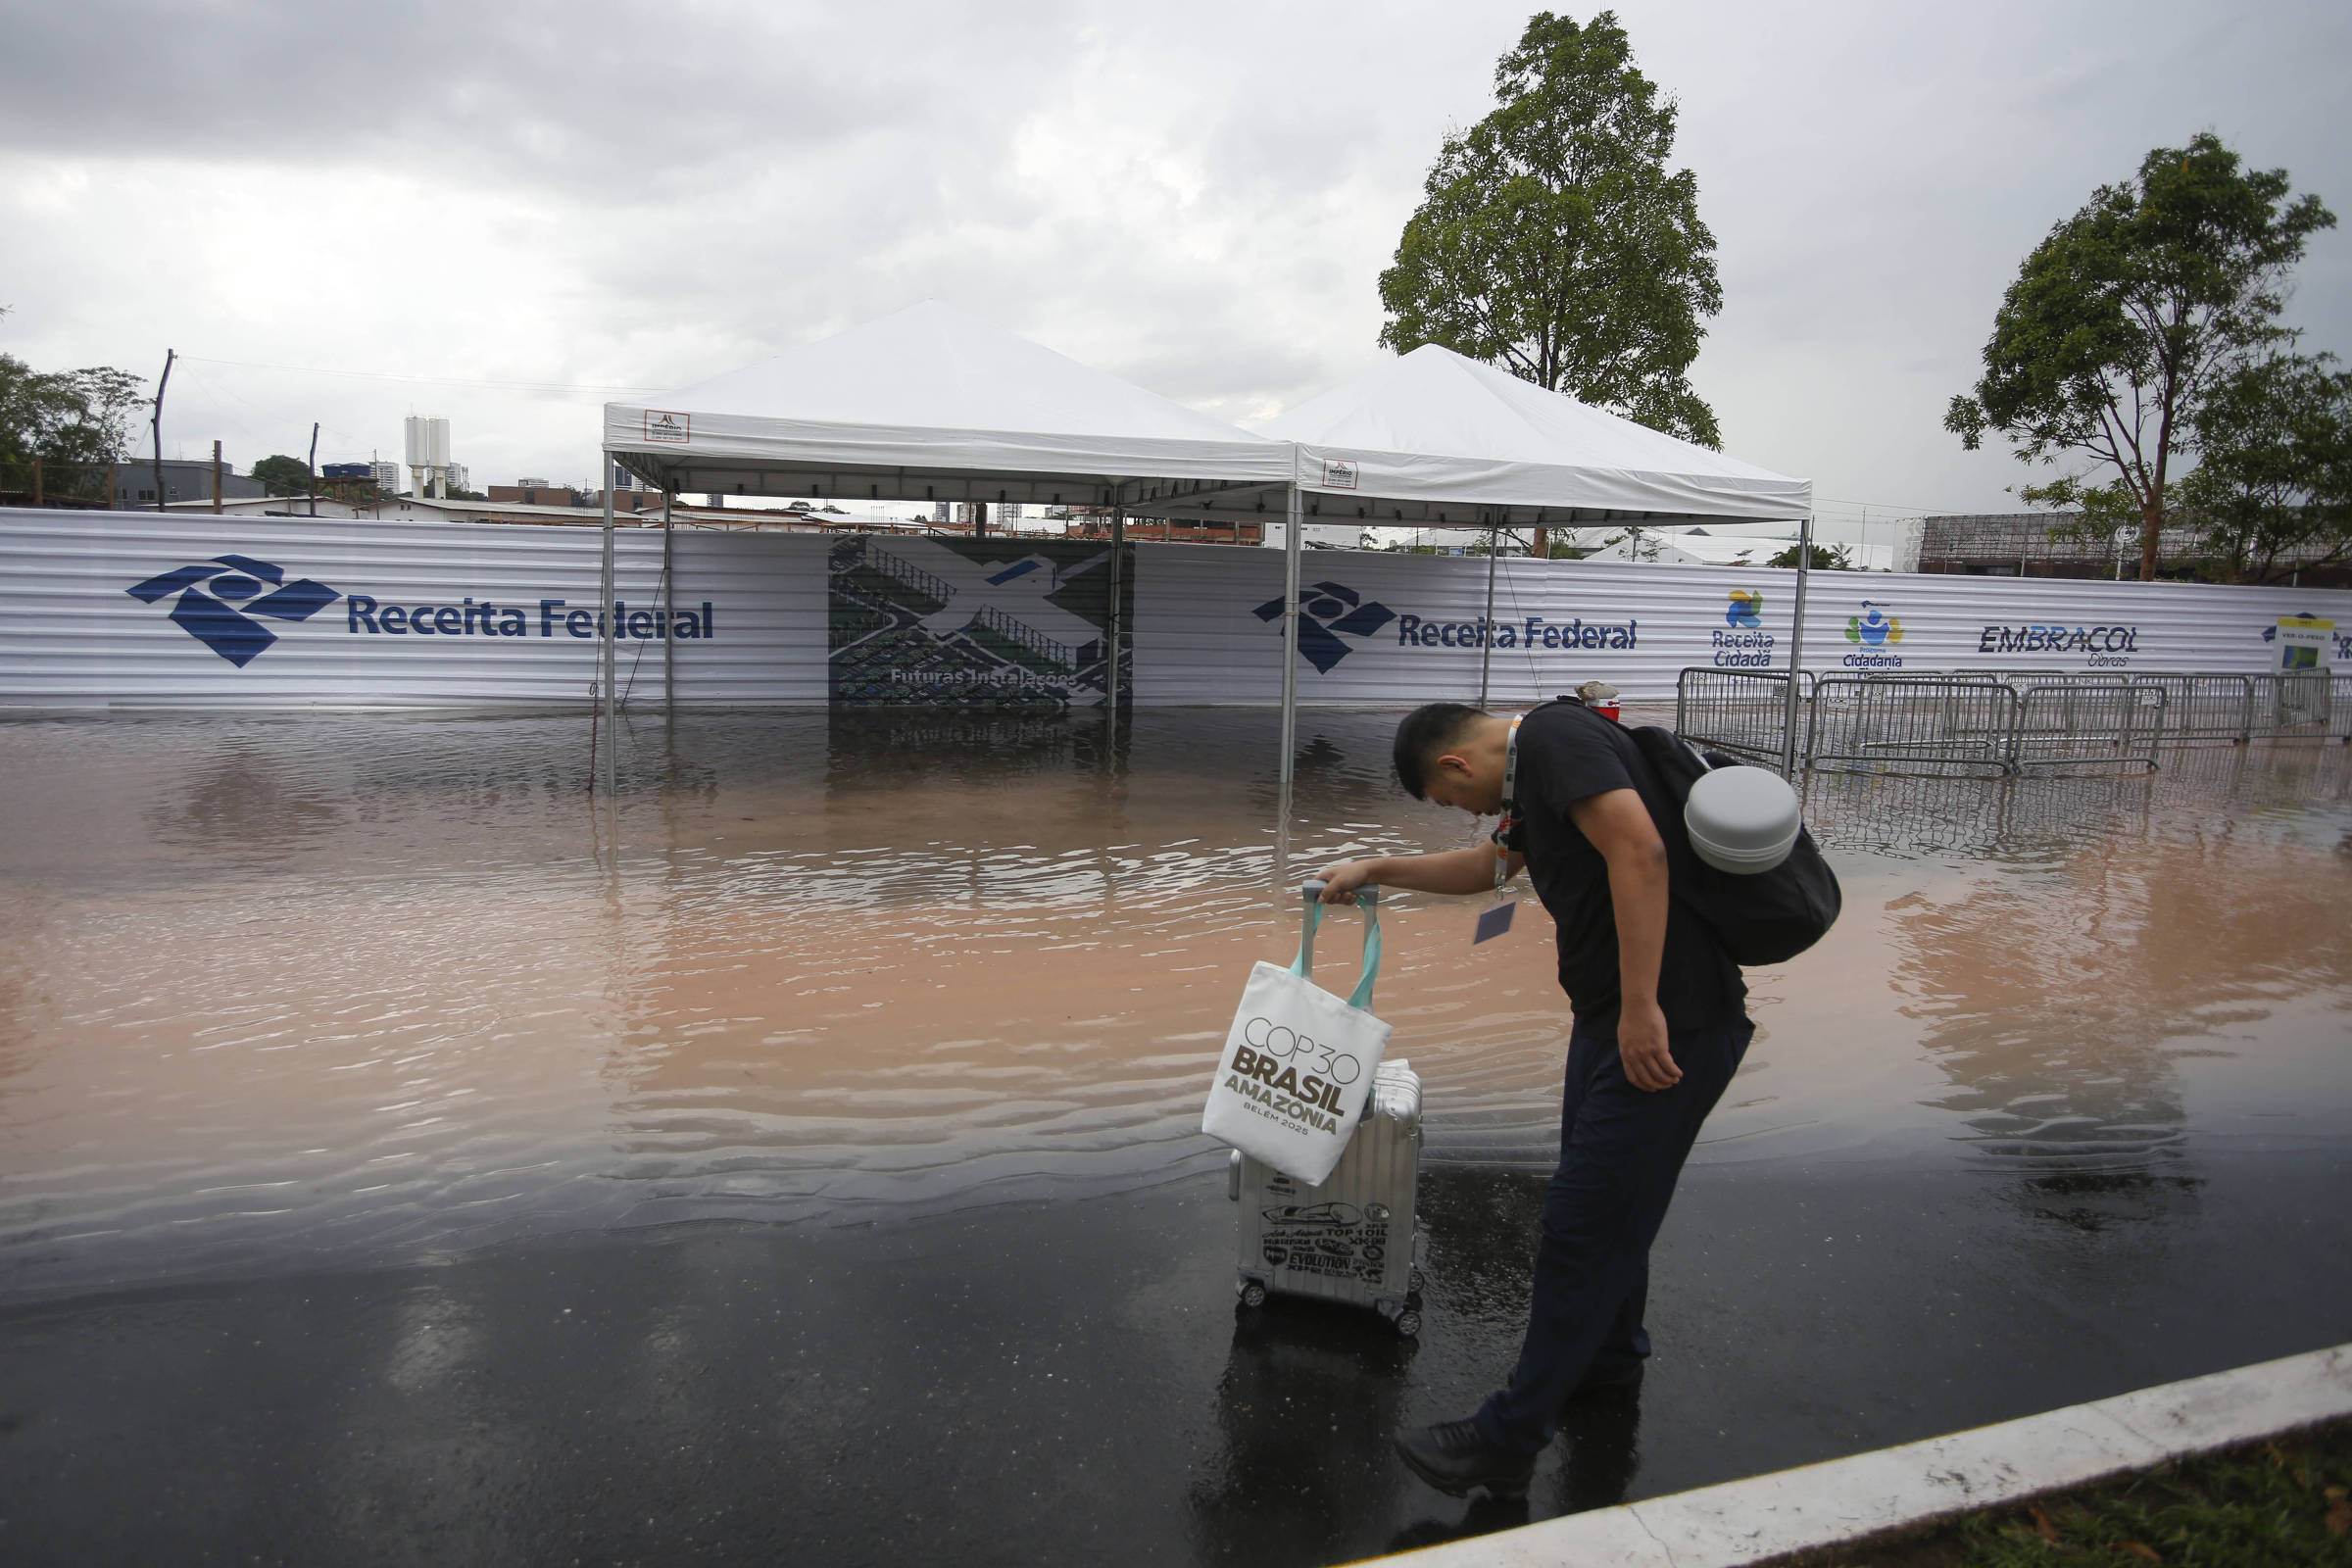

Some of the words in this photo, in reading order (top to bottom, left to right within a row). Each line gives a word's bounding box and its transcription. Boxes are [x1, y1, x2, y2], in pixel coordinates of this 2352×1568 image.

[348, 594, 527, 637] Receita
[540, 599, 714, 639] Federal
[1398, 613, 1517, 649] Receita
[1524, 616, 1638, 649] Federal
[1712, 630, 1775, 648] Receita
[1979, 625, 2140, 653] EMBRACOL
[1714, 649, 1772, 667] Cidadã
[1842, 654, 1902, 667] Cidadania
[891, 668, 964, 685] Futuras
[970, 667, 1078, 692] Instalações
[1231, 1044, 1346, 1117] BRASIL
[1224, 1074, 1337, 1136] AMAZÔNIA
[1243, 1101, 1280, 1123] BELÉM
[1280, 1118, 1309, 1136] 2025
[1326, 1228, 1353, 1237] TOP
[1289, 1252, 1350, 1270] EVOLUTION
